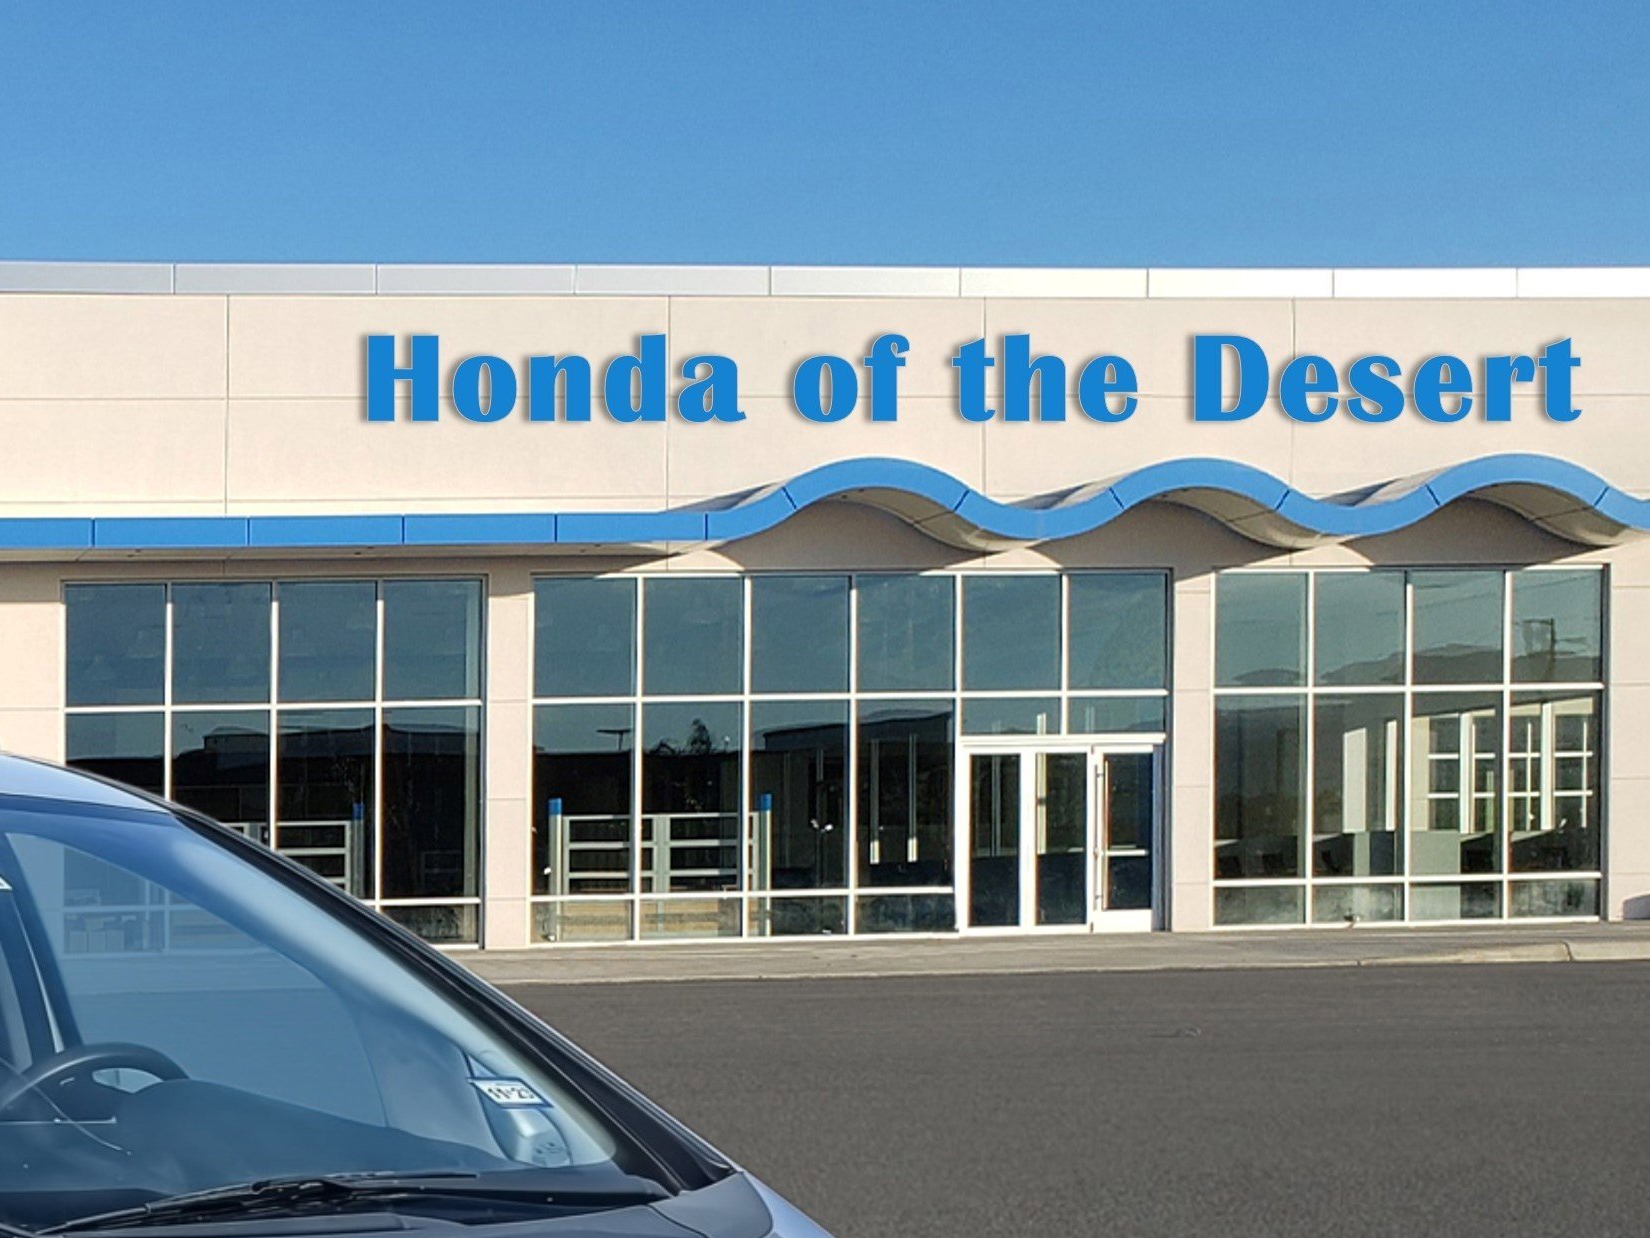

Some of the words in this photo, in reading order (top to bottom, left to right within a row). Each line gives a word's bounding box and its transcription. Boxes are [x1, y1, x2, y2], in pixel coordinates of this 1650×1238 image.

[368, 335, 745, 422] Honda
[795, 334, 909, 422] of
[953, 335, 1137, 422] the
[1195, 336, 1580, 422] Desert
